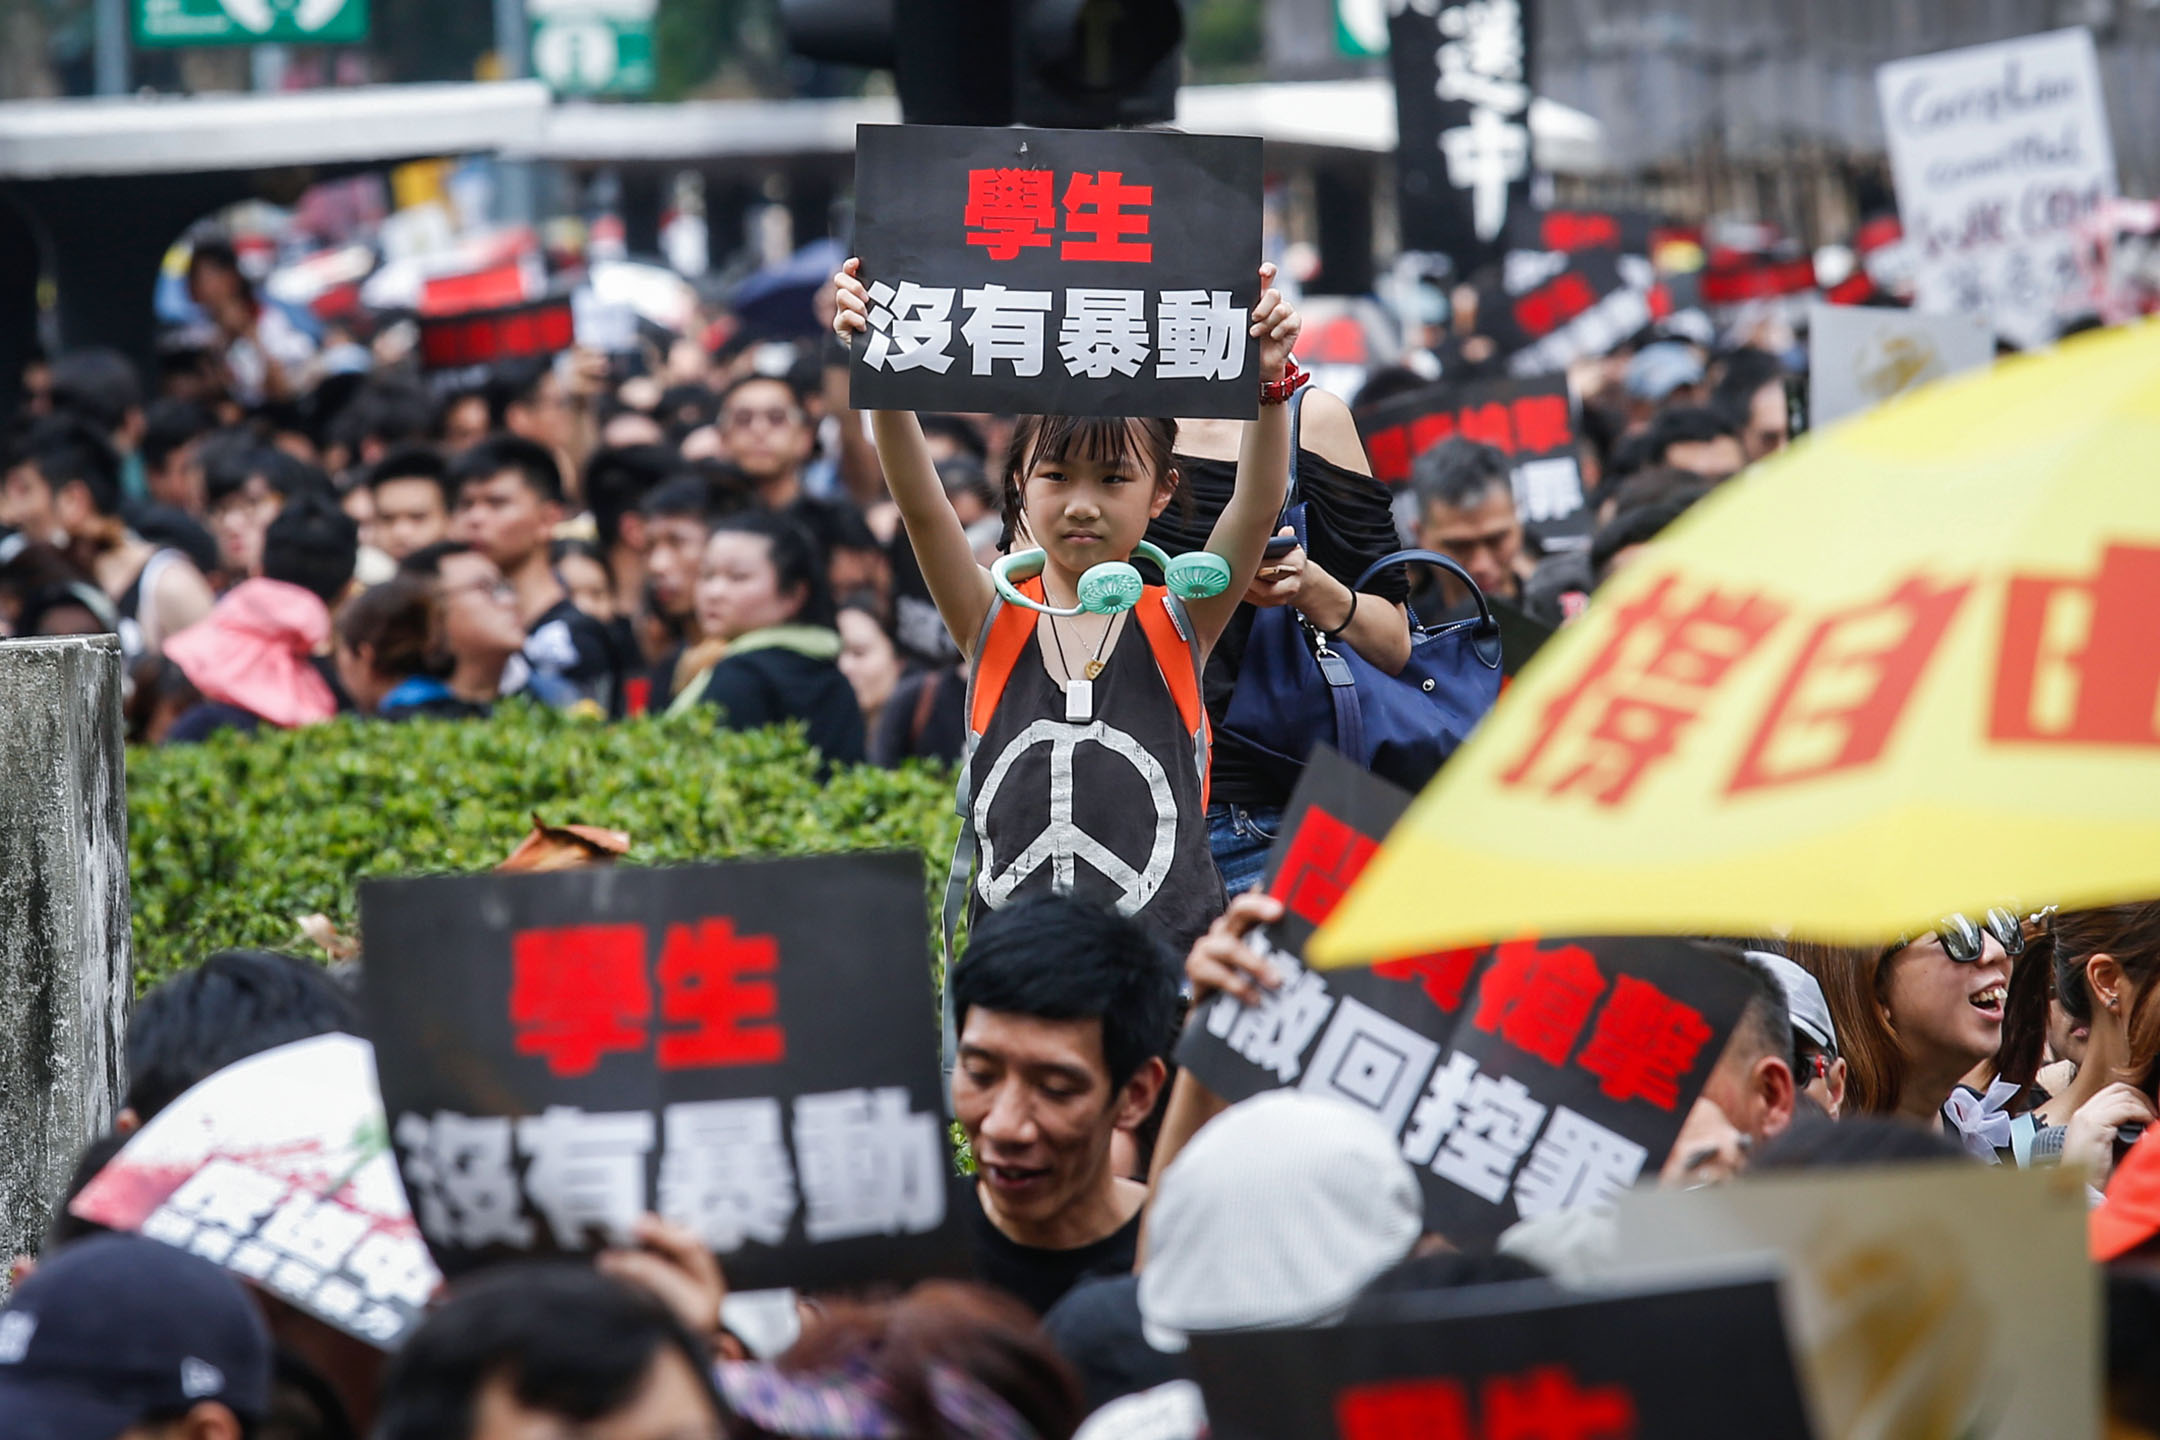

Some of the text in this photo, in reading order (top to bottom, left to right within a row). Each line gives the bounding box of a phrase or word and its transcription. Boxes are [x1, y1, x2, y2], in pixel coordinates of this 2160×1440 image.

[964, 167, 1153, 263] 學生
[862, 280, 1249, 382] 沒有暴動
[510, 916, 786, 1077] 學生
[395, 1086, 949, 1252] 沒有暴動
